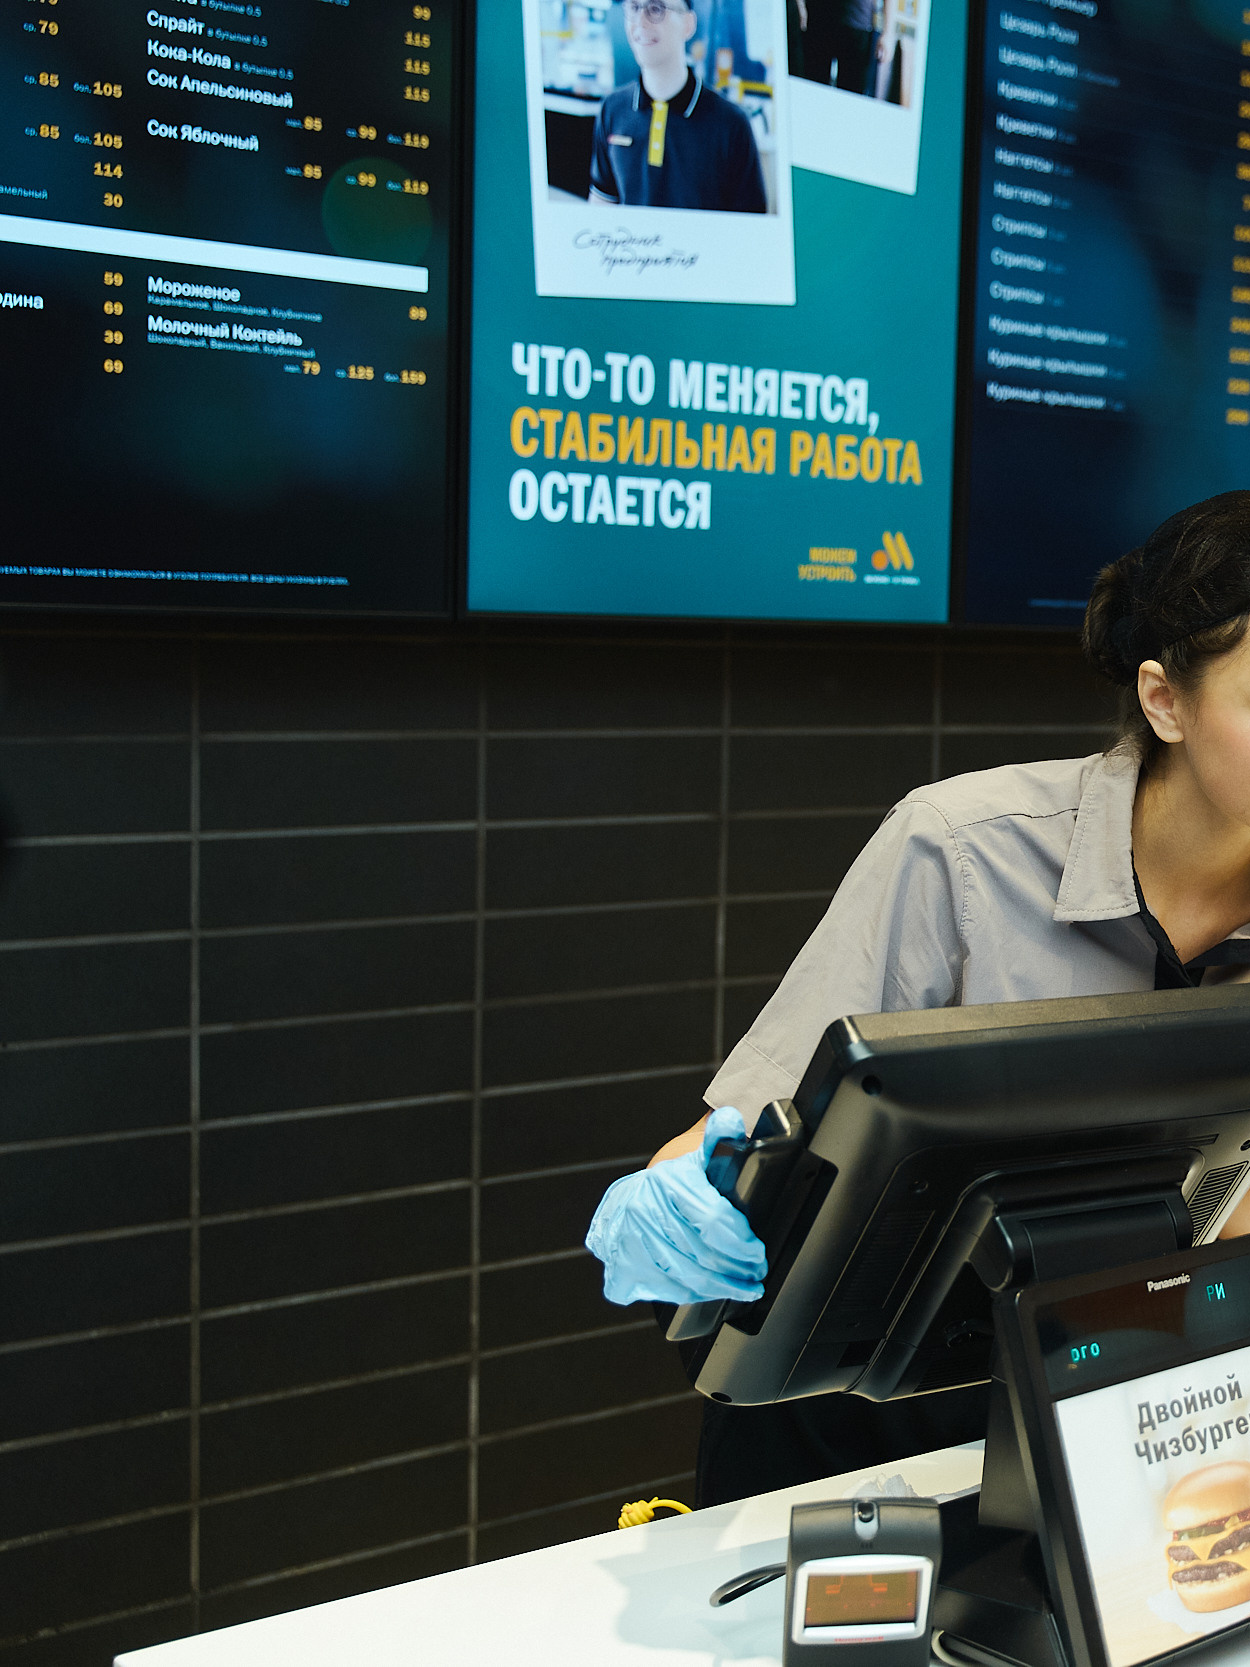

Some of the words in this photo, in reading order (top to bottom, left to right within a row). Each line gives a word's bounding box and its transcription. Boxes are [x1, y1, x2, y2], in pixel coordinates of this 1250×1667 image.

[38, 20, 59, 36] 79
[146, 9, 205, 35] Спрайт
[403, 30, 431, 48] 115
[147, 38, 231, 70] Кока-Кола
[403, 57, 431, 75] 115
[38, 71, 60, 88] 85
[93, 80, 123, 98] 105
[146, 68, 178, 89] Сок
[180, 74, 294, 109] Апельсиновый
[403, 85, 431, 103] 115
[39, 123, 60, 139] 85
[93, 131, 123, 149] 105
[146, 118, 178, 140] Сок
[180, 124, 260, 152] Яблочный
[93, 161, 123, 178] 114
[103, 192, 124, 208] 30
[103, 271, 124, 287] 59
[147, 275, 241, 302] Мороженое
[103, 329, 124, 345] 39
[147, 314, 230, 339] Молочный
[232, 323, 303, 347] Коктейль
[302, 360, 321, 376] 79
[512, 342, 656, 405] ЧТО-ТО
[668, 359, 880, 435] МЕНЯЕТСЯ,
[510, 407, 777, 475] СТАБИЛЬНАЯ
[789, 430, 922, 485] РАБОТА
[509, 469, 711, 530] ОСТАЕТСЯ
[1147, 1273, 1190, 1292] Panasonic
[1137, 1374, 1243, 1434] Двойной
